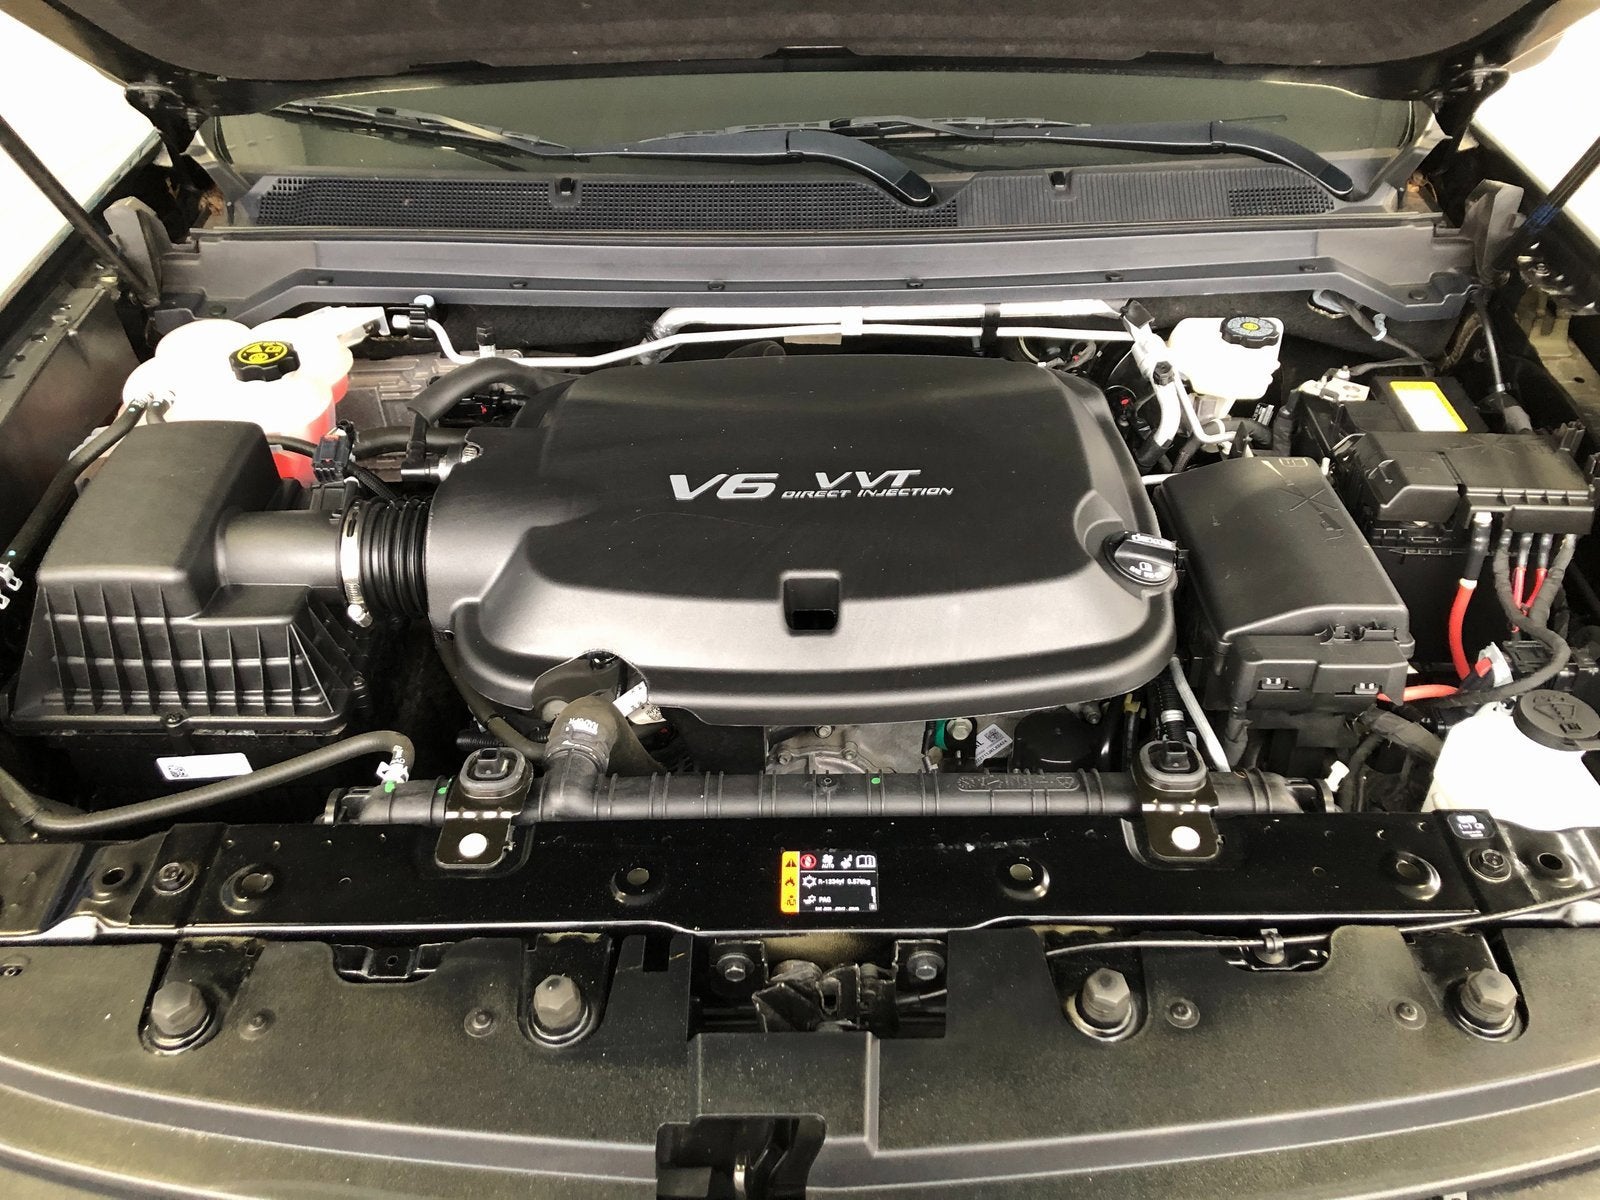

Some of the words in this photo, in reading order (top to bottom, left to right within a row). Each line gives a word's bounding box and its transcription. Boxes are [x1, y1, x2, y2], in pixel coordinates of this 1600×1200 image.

[669, 473, 779, 500] V6
[815, 469, 921, 489] VVT
[781, 489, 851, 499] DIRECT
[857, 487, 954, 498] INJECTION
[817, 878, 845, 886] R-1234yf
